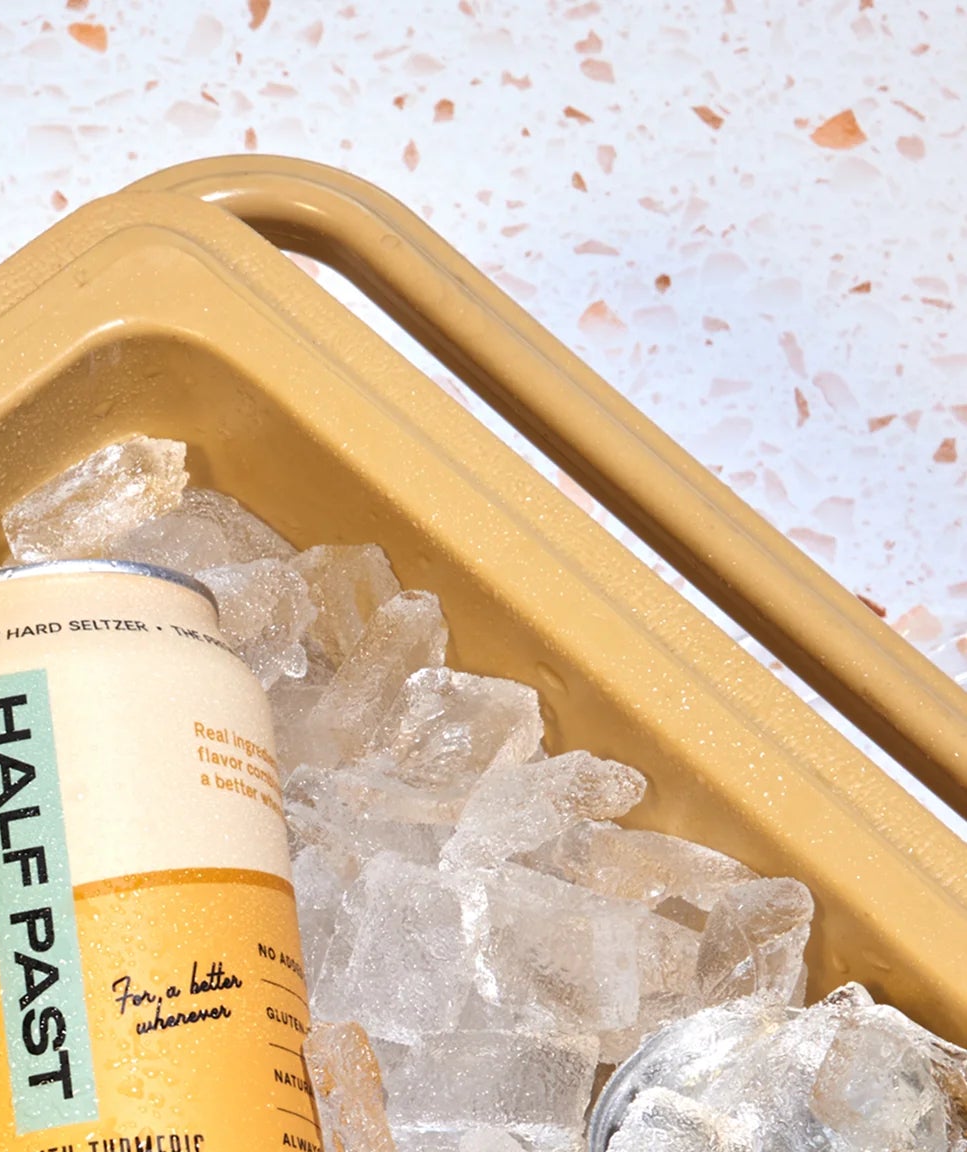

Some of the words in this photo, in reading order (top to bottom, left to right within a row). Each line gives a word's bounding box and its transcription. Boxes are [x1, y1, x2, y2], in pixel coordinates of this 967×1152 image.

[6, 621, 63, 641] HARD
[68, 618, 149, 633] SELTZER
[194, 721, 229, 744] Real
[197, 745, 243, 771] flavor
[200, 773, 211, 786] a
[215, 772, 258, 800] better
[258, 942, 276, 961] NO
[166, 985, 181, 999] a
[189, 960, 243, 995] better
[9, 907, 75, 1101] PAST
[136, 996, 232, 1035] wherever
